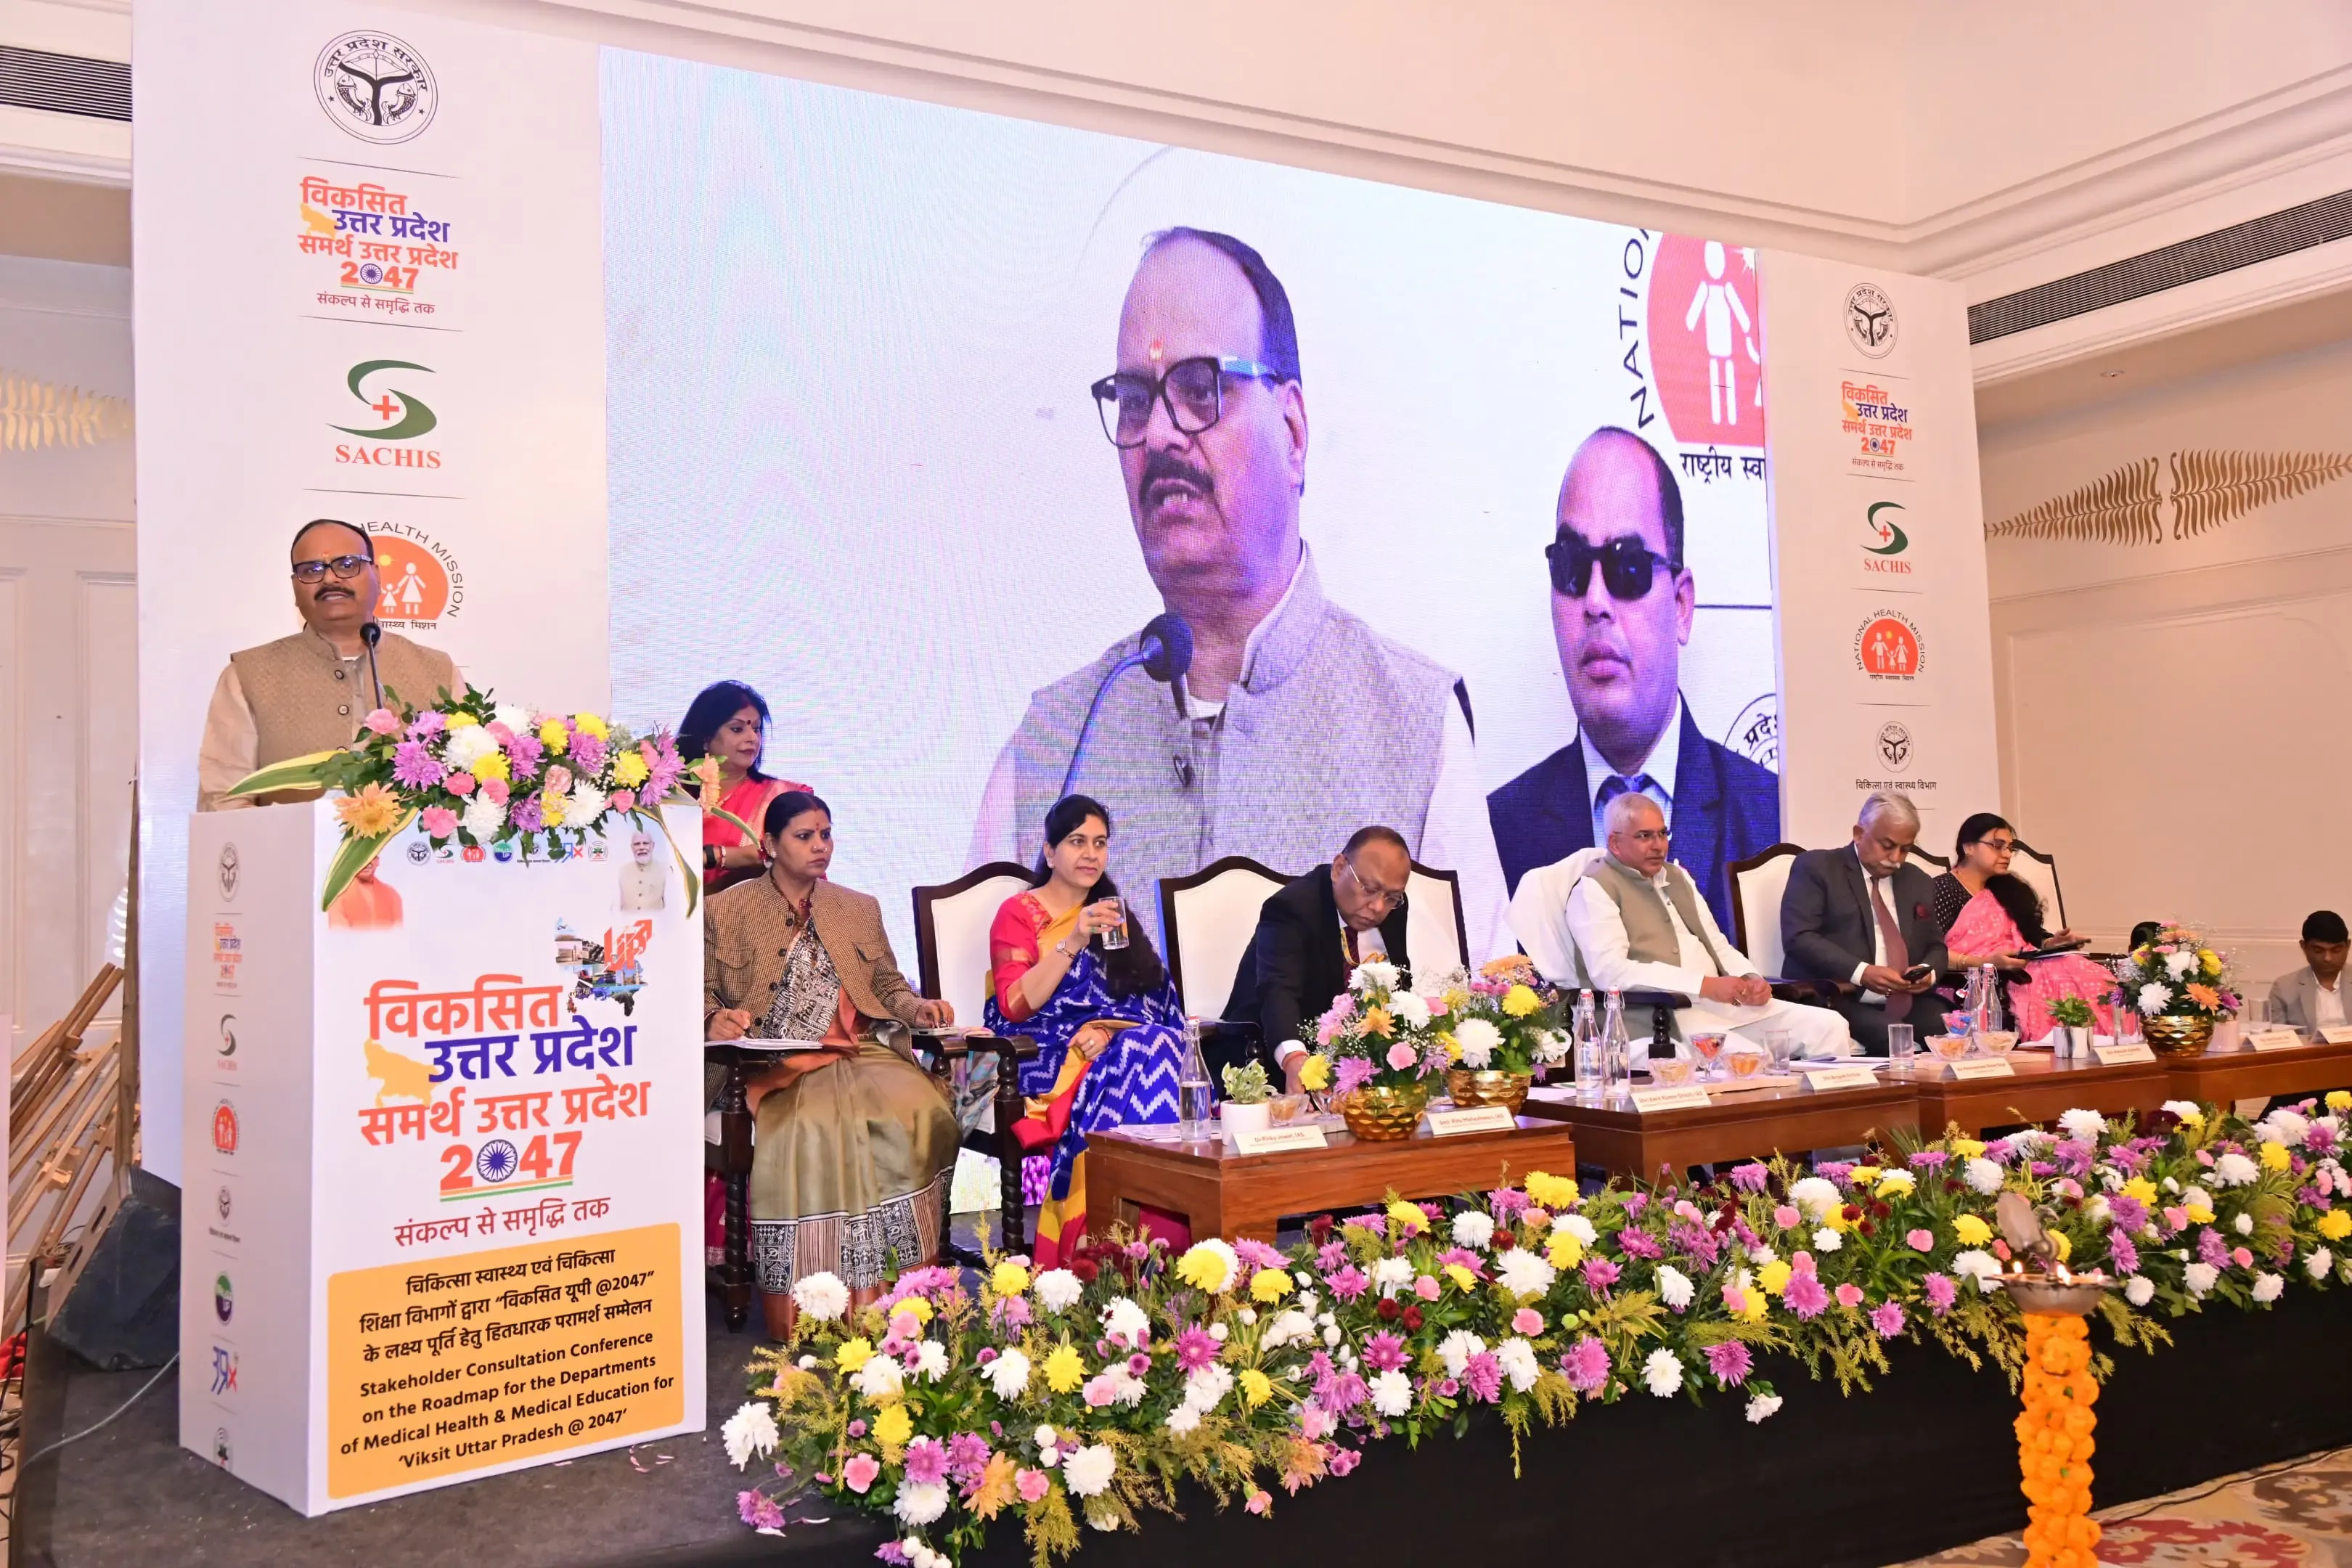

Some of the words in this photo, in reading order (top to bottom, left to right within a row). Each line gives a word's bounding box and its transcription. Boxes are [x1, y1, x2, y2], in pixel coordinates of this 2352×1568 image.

[324, 49, 345, 78] उत्तर
[344, 36, 389, 52] प्रदेश
[393, 46, 428, 92] सरकार
[300, 176, 408, 215] विकसित
[332, 209, 383, 235] उत्तर
[389, 211, 451, 242] प्रदेश
[297, 234, 354, 258] समर्थ
[359, 241, 402, 264] उत्तर
[407, 243, 459, 269] प्रदेश
[317, 291, 357, 307] संकल्प
[360, 294, 372, 309] से
[375, 297, 411, 314] समृद्धि
[413, 302, 436, 314] तक
[1619, 228, 1655, 429] NATIO
[1841, 381, 1889, 406] विकसित
[1855, 403, 1879, 420] उत्तर
[1881, 403, 1908, 423] प्रदेश
[1842, 418, 1867, 435] समर्थ
[1869, 423, 1887, 438] उत्तर
[1890, 423, 1912, 441] प्रदेश
[335, 444, 441, 469] SACHIS
[1680, 445, 1732, 484] राष्ट्रीय
[431, 542, 464, 618] MISSION
[1863, 558, 1911, 573] SACHIS
[410, 619, 437, 630] मिशन
[1853, 617, 1873, 671] NATIONAL
[1873, 608, 1908, 624] HEALTH
[1908, 622, 1926, 673] MISSION
[1855, 778, 1882, 790] चिकित्सा
[1917, 779, 1937, 790] विभाग
[364, 973, 563, 1040] विकसित
[425, 1034, 519, 1083] उत्तर
[530, 1015, 637, 1075] प्रदेश
[358, 1086, 466, 1146] समर्थ
[474, 1091, 553, 1134] उत्तर
[560, 1073, 651, 1124] प्रदेश
[394, 1218, 470, 1247] संकल्प
[476, 1207, 497, 1235] से
[502, 1197, 566, 1236] समृद्धि
[572, 1197, 611, 1221] तक
[406, 1273, 472, 1296] चिकित्सा
[475, 1263, 528, 1284] स्वास्थ्य
[531, 1255, 554, 1275] एवं
[556, 1249, 616, 1271] चिकित्सा
[359, 1312, 402, 1334] शिक्षा
[405, 1299, 458, 1326] विभागों
[460, 1298, 491, 1320] द्वारा
[565, 1277, 592, 1303] यूपी
[363, 1344, 381, 1363] के
[384, 1339, 423, 1359] लक्ष्य
[426, 1326, 458, 1357] पूर्ति
[459, 1328, 483, 1349] हेतु
[486, 1317, 552, 1342] हितधारक
[555, 1303, 601, 1328] परामर्श
[603, 1299, 653, 1320] सम्मेलन
[360, 1368, 462, 1397] Stakeholder
[466, 1349, 566, 1376] Consultation
[571, 1332, 654, 1357] Conference
[362, 1410, 384, 1424] on
[388, 1402, 417, 1418] the
[422, 1387, 499, 1412] Roadmap
[504, 1381, 526, 1396] for
[530, 1376, 556, 1391] the
[560, 1355, 656, 1384] Departments
[340, 1437, 359, 1455] of
[364, 1423, 430, 1451] Medical
[436, 1413, 489, 1436] Health
[494, 1409, 506, 1423] &
[511, 1395, 572, 1420] Medical
[576, 1381, 650, 1407] Education
[654, 1376, 674, 1390] for
[456, 1439, 497, 1458] Uttar
[502, 1423, 563, 1447] Pradesh
[568, 1419, 584, 1436] @
